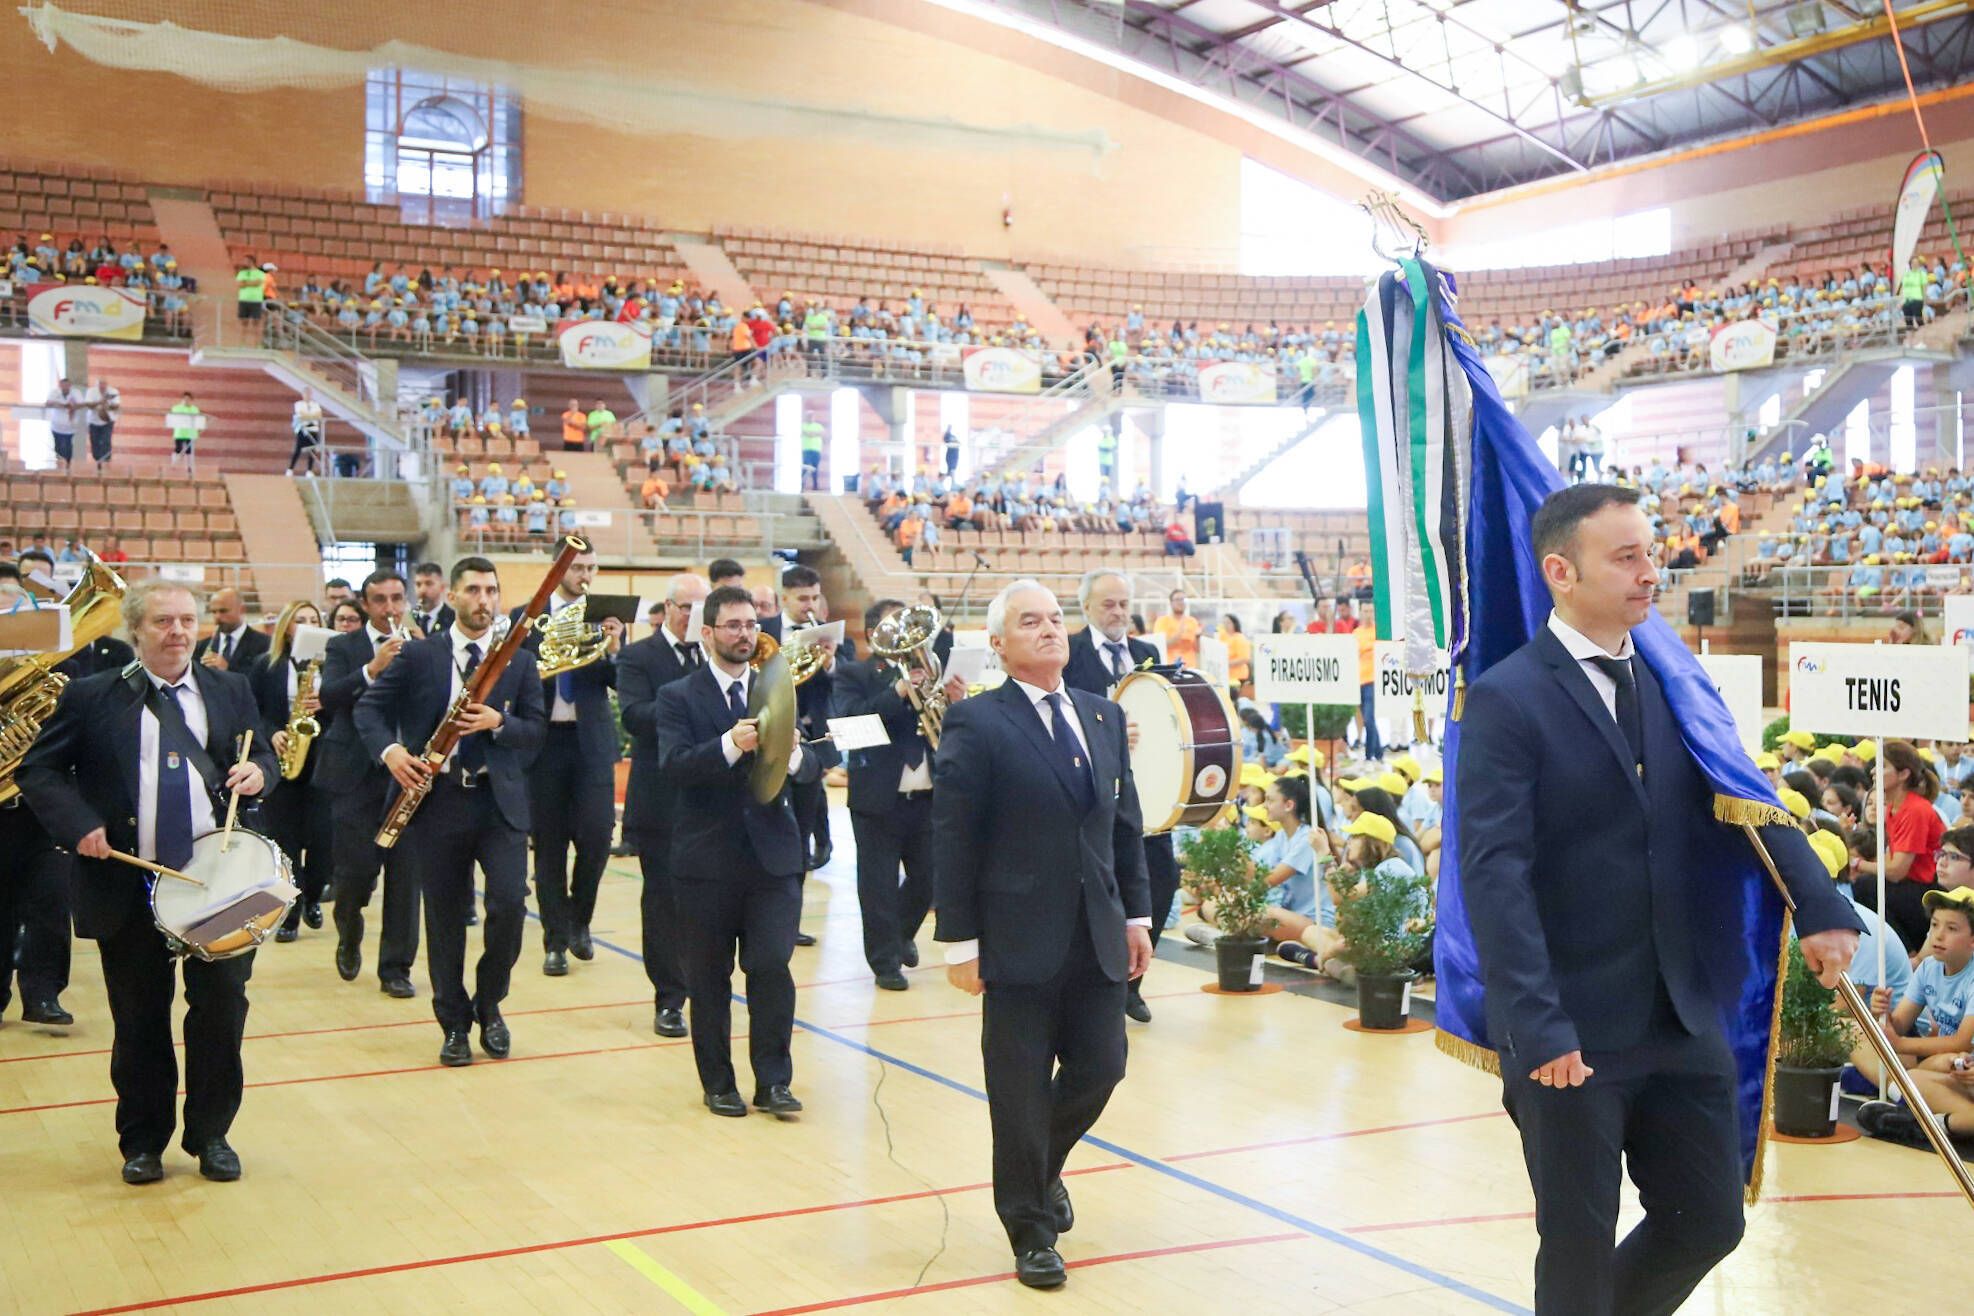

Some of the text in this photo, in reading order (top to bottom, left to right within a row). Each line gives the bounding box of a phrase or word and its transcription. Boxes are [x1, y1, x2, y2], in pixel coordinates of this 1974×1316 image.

[1271, 652, 1339, 682] PIRAGÜISMO
[1382, 669, 1450, 696] PSICMO
[1845, 677, 1901, 712] TENIS
